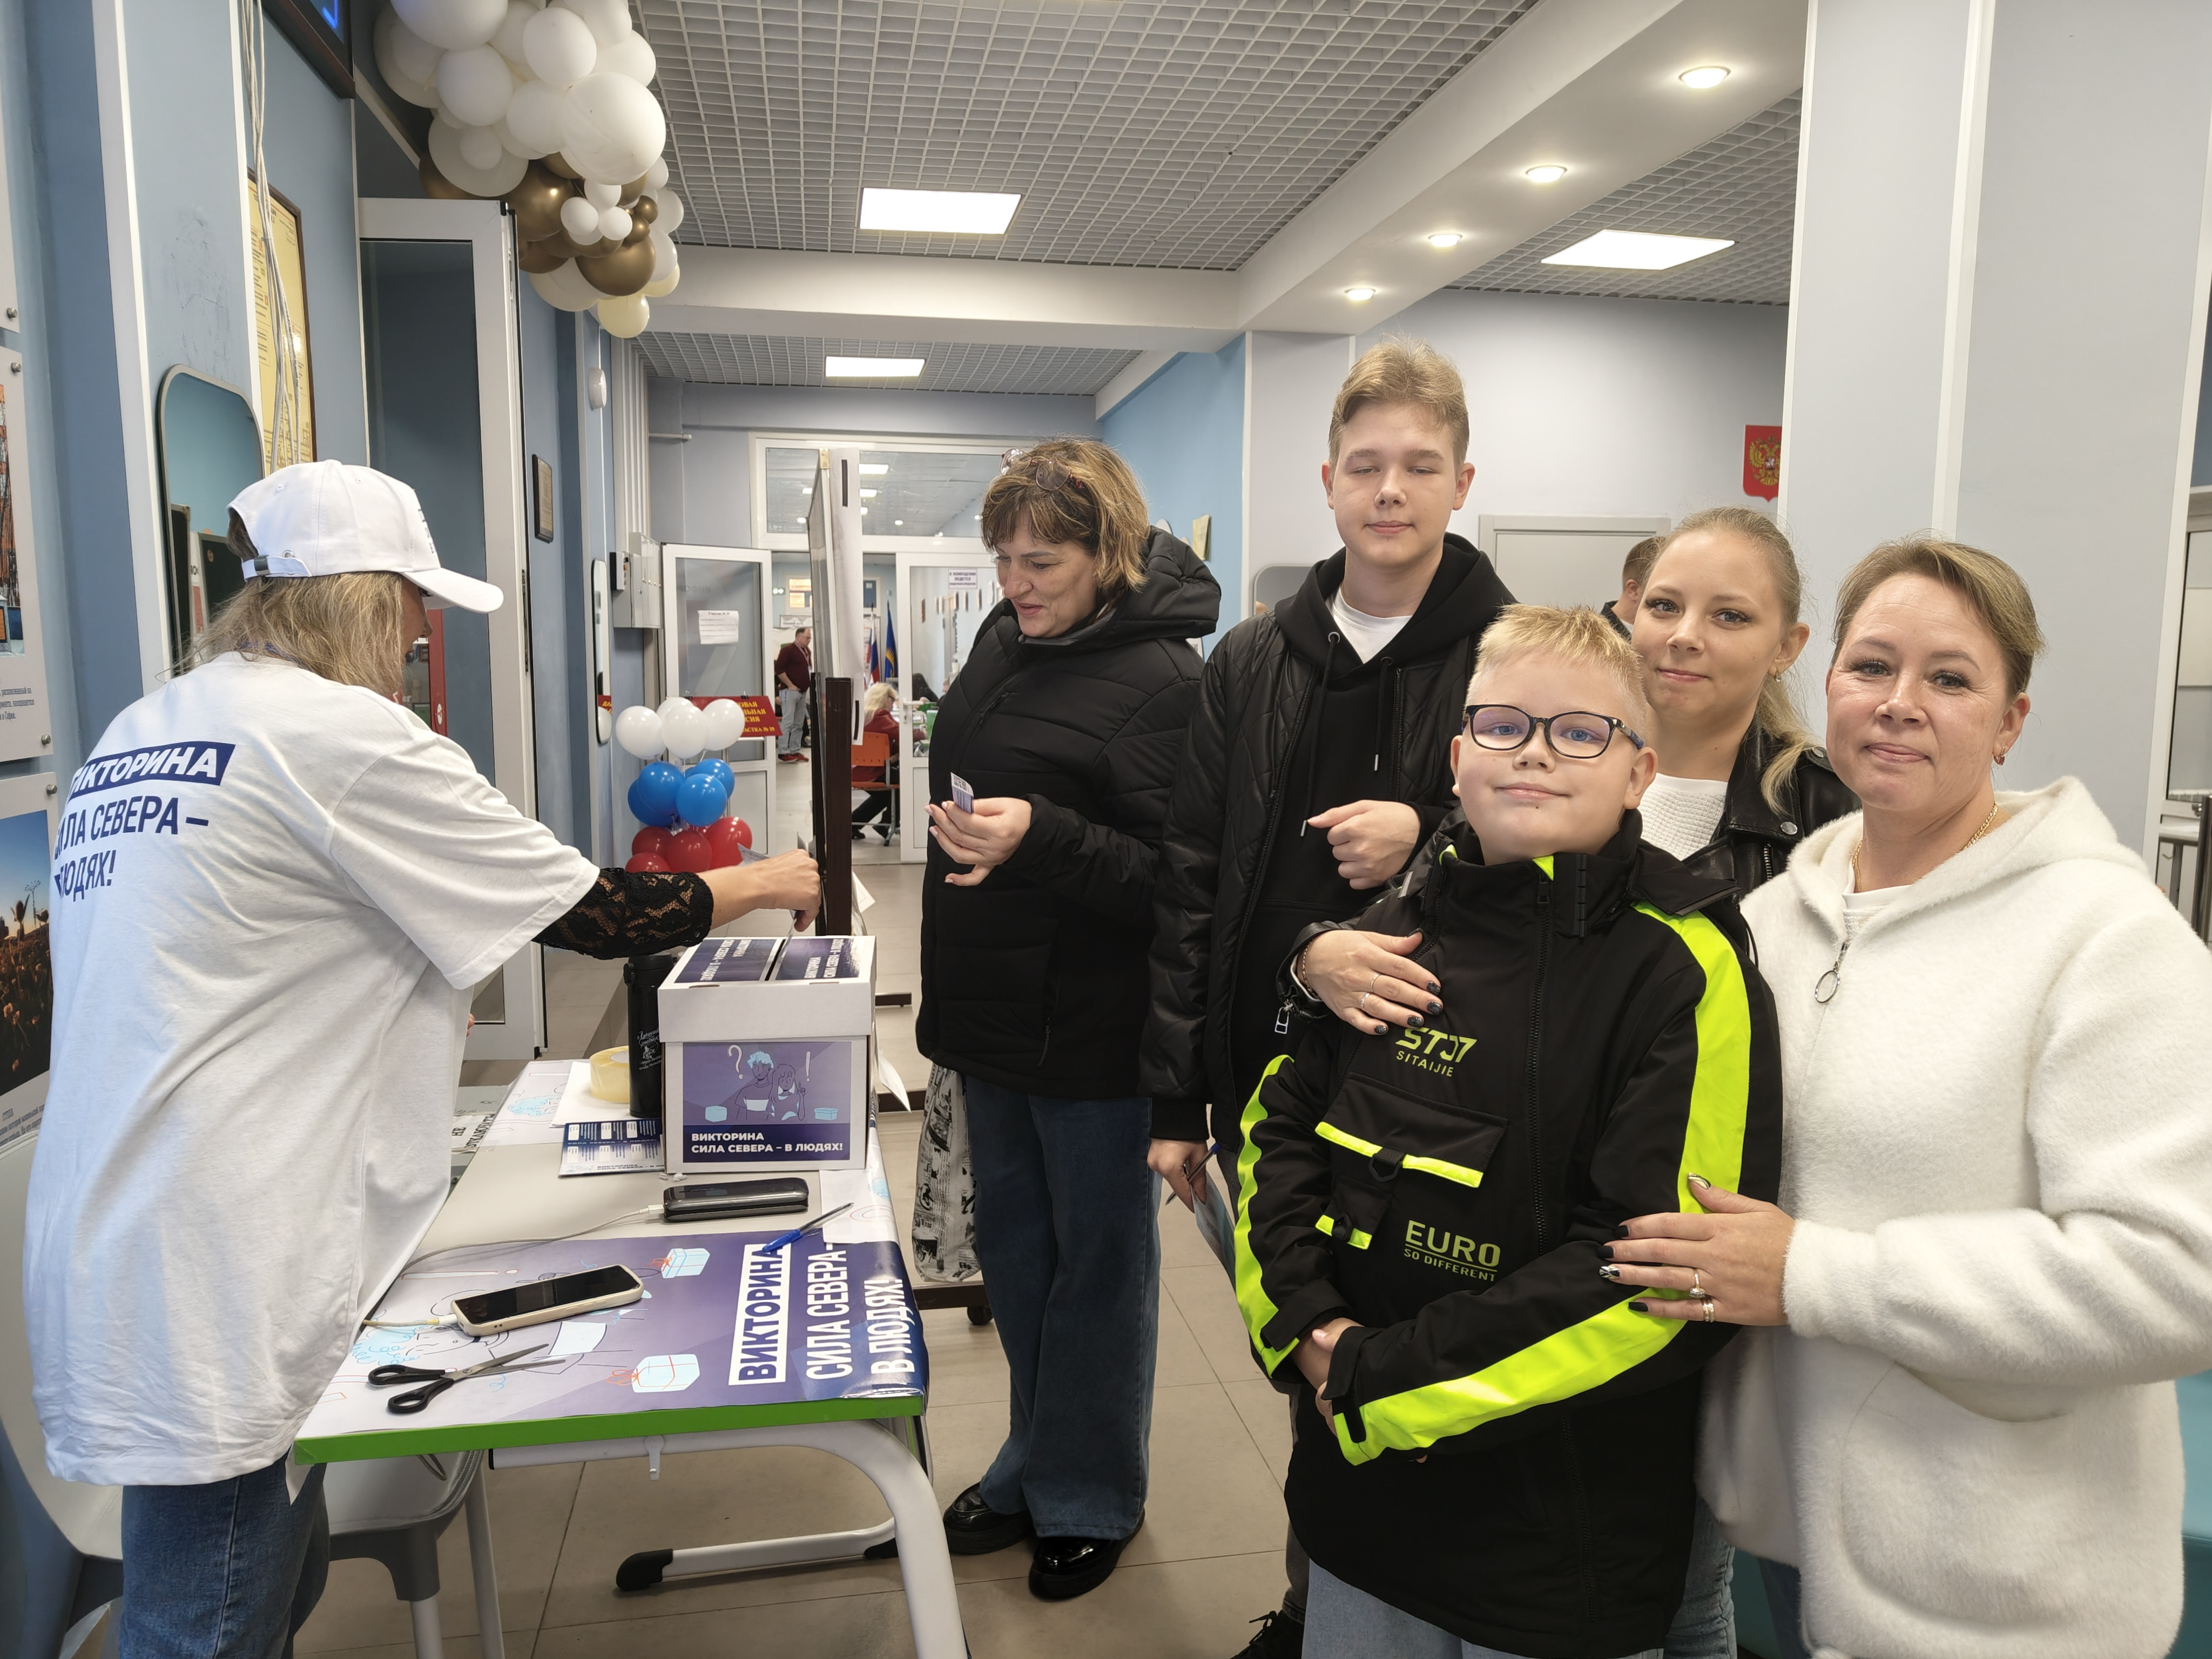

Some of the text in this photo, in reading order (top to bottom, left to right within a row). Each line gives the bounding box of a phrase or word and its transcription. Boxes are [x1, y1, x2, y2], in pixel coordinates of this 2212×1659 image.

[72, 747, 218, 794] ИКТОРИНА
[91, 795, 179, 841] СЕВЕРА
[1396, 1050, 1454, 1077] SITAIJIE
[451, 1127, 467, 1136] НЕ
[691, 1132, 765, 1142] ВИКТОРИНА
[691, 1144, 725, 1153] СИЛА
[728, 1144, 773, 1153] СЕВЕРА
[785, 1144, 793, 1152] В
[795, 1143, 843, 1152] ЛЮДЯХ!
[1404, 1248, 1495, 1282] SO DIFFERENT
[1405, 1219, 1501, 1267] EURO
[738, 1245, 784, 1381] ВИКТОРИНА
[864, 1279, 915, 1374] В ЛЮДЯХ!
[806, 1319, 853, 1380] СИЛА
